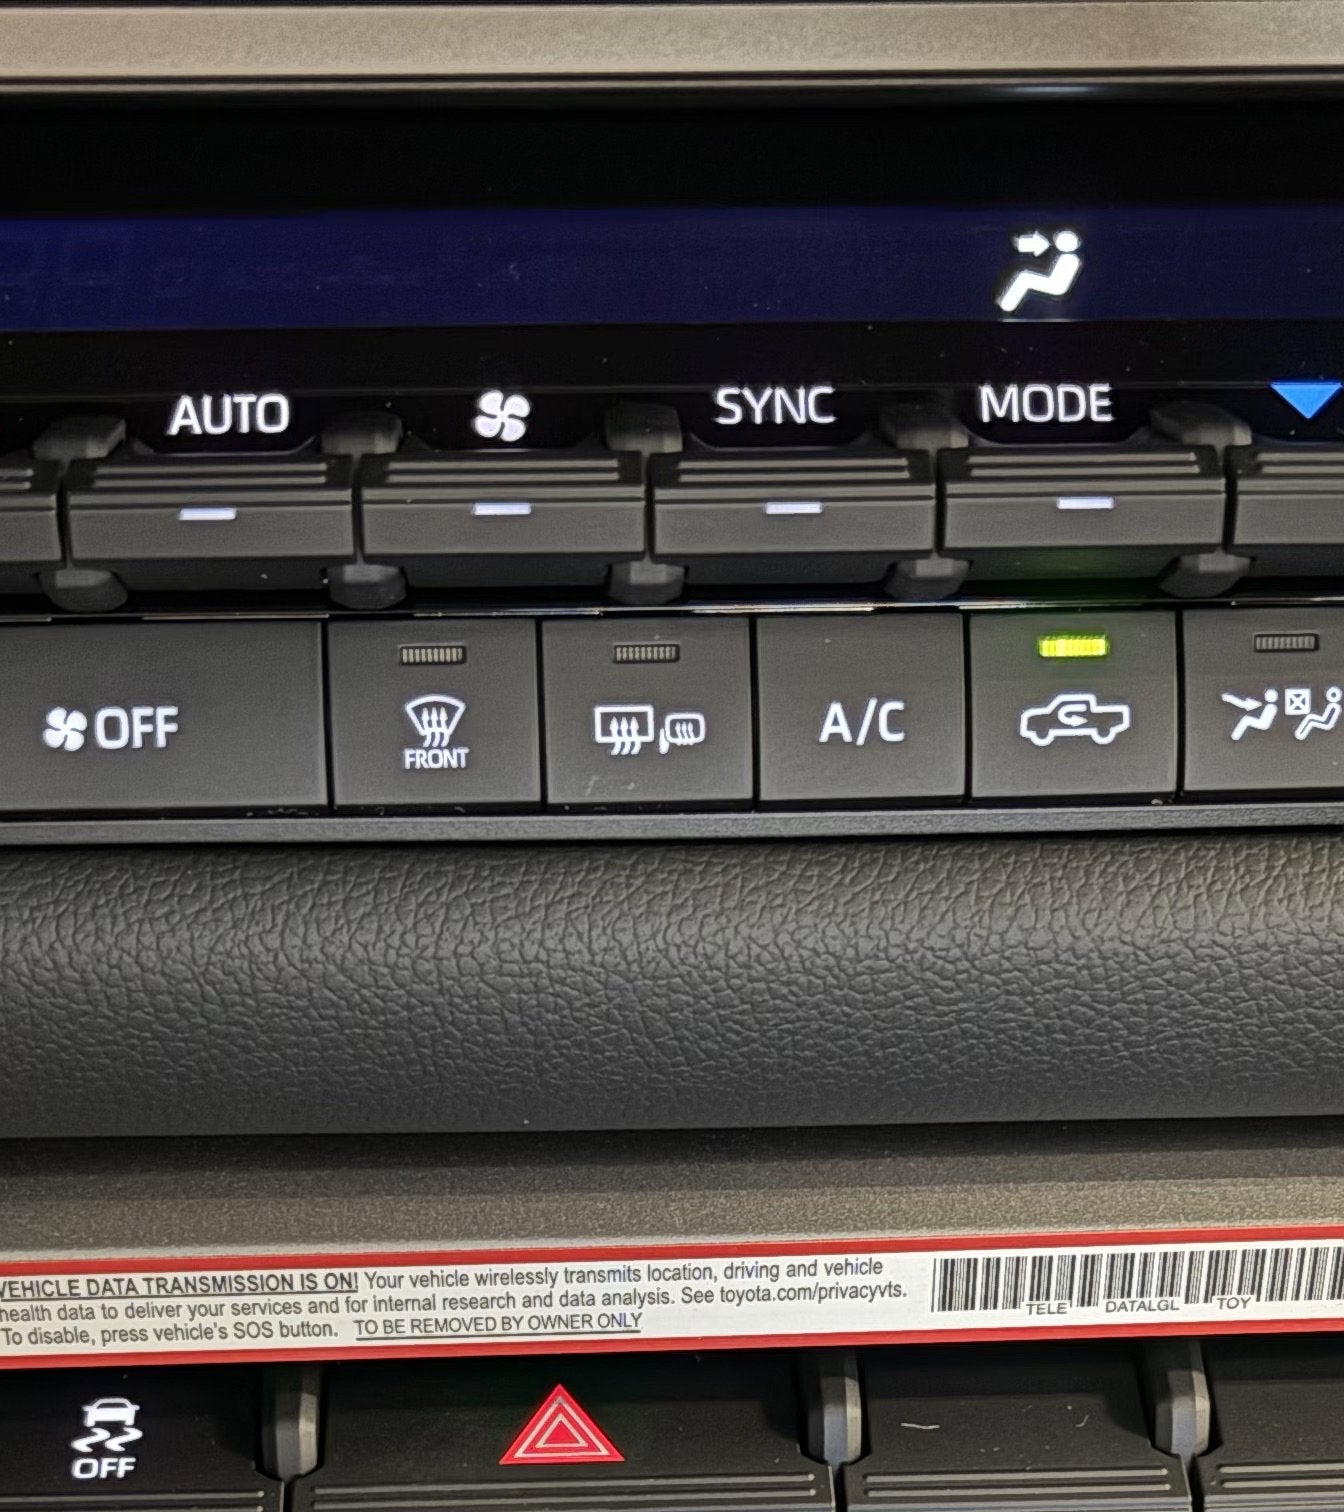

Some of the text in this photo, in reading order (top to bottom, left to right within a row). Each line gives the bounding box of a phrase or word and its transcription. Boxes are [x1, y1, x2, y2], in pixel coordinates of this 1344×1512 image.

[167, 392, 291, 435] AUTO
[715, 386, 836, 425] SYNC
[979, 383, 1113, 423] MODE
[94, 705, 180, 749] OFF
[819, 698, 907, 747] A/C
[404, 746, 469, 769] FRONT
[87, 1278, 139, 1296] DATA
[143, 1273, 294, 1295] TRANSMISSION
[300, 1273, 318, 1291] IS
[324, 1272, 358, 1290] ON!
[364, 1271, 405, 1290] Your
[409, 1269, 469, 1288] vehicle
[475, 1266, 558, 1289] wirelessly
[564, 1265, 641, 1285] transmits
[647, 1263, 718, 1283] location,
[723, 1261, 779, 1282] driving
[786, 1259, 818, 1277] and
[824, 1257, 883, 1276] vehicle
[57, 1304, 95, 1321] data
[101, 1303, 118, 1319] to
[125, 1302, 182, 1319] deliver
[188, 1303, 225, 1321] your
[231, 1298, 302, 1316] services
[308, 1297, 339, 1314] and
[345, 1296, 368, 1313] for
[373, 1293, 436, 1312] internal
[442, 1291, 516, 1310] research
[522, 1291, 553, 1308] and
[559, 1290, 596, 1307] data
[602, 1287, 675, 1309] analysis.
[681, 1286, 714, 1304] See
[720, 1281, 907, 1307] toyota.com/privacyvts.
[1026, 1296, 1252, 1316] TELE DATALGL TOY
[0, 1312, 643, 1347] To disable, press vehicle's SOS button. TO BE REMOVED BY OWNER ONLY
[71, 1455, 138, 1480] OFF
